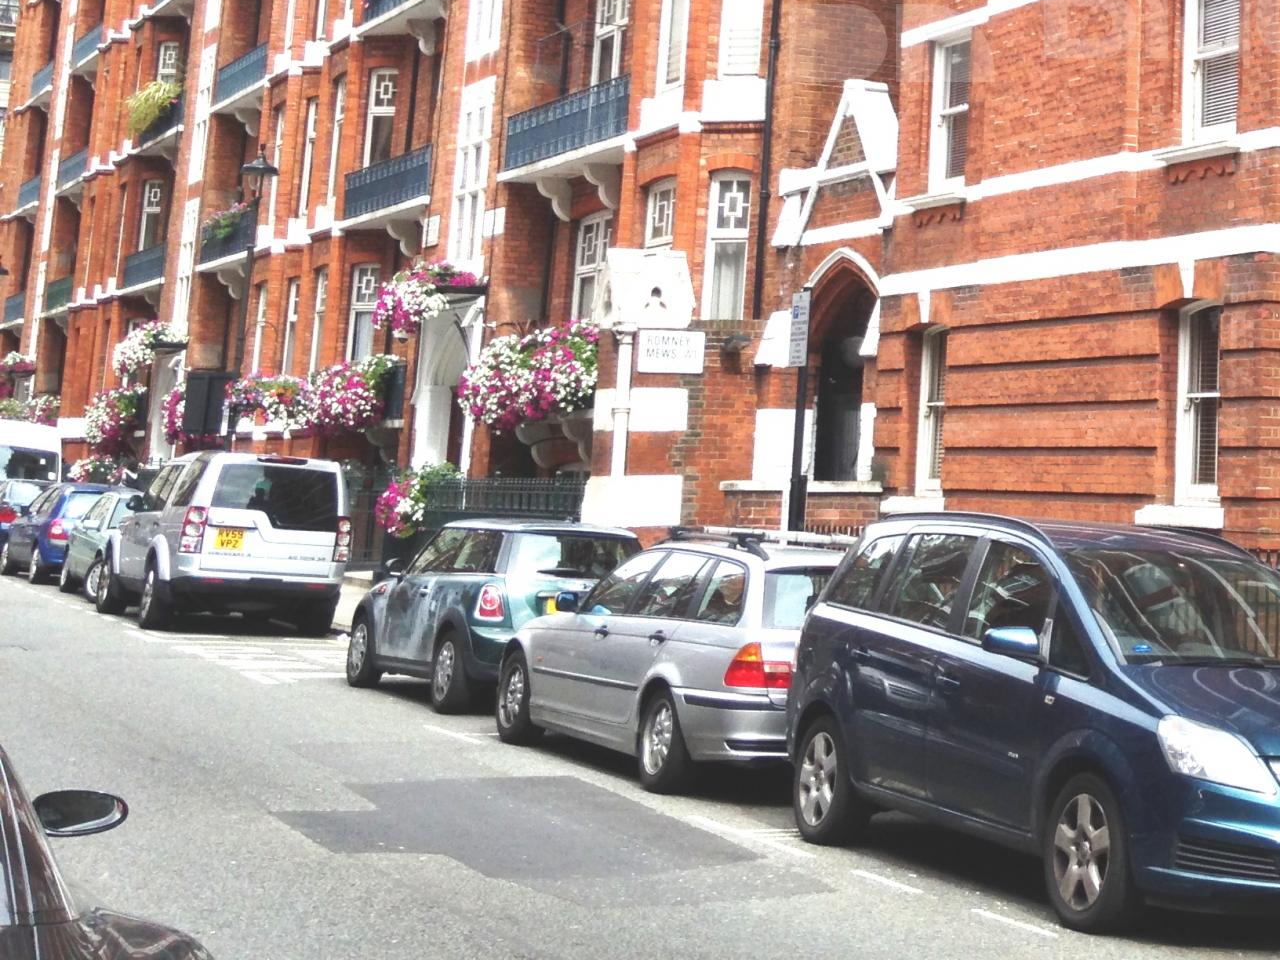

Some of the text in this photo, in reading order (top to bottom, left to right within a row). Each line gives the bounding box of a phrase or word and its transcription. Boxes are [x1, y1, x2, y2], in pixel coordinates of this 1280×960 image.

[647, 335, 691, 346] ROMNEY
[646, 348, 677, 359] MEWS
[219, 539, 239, 549] VPZ
